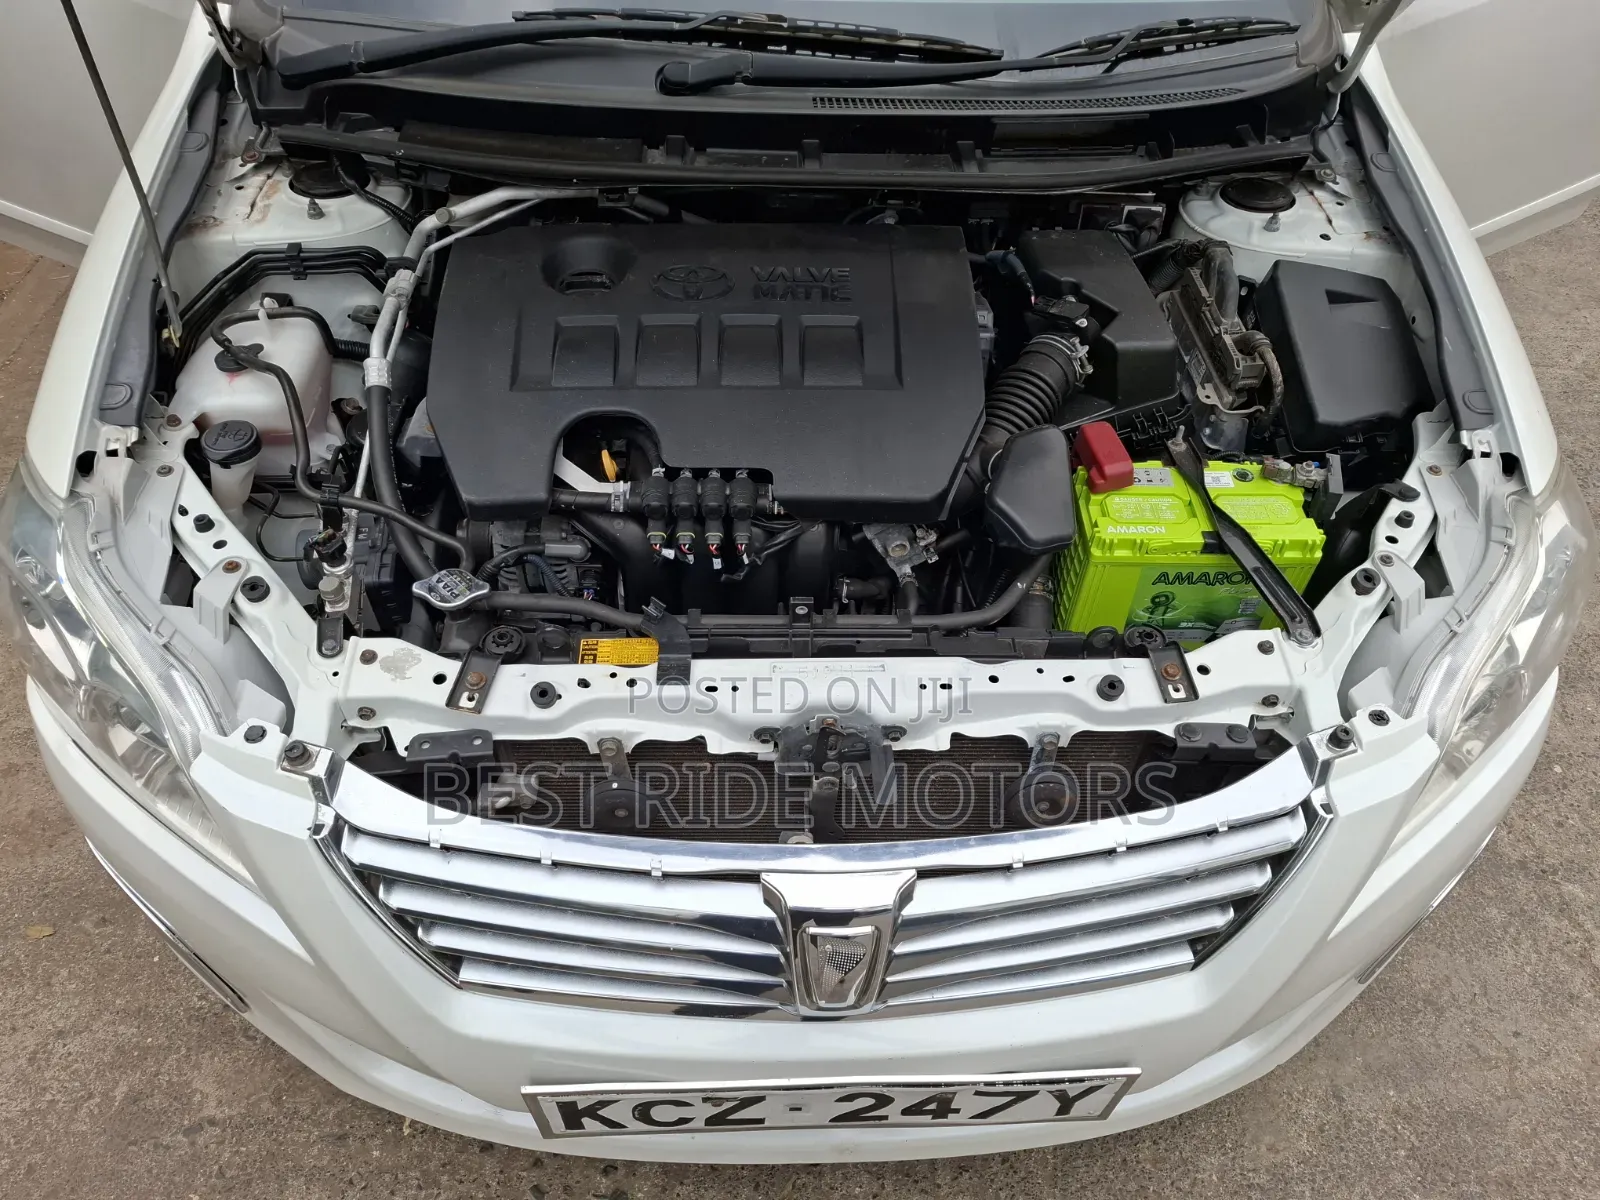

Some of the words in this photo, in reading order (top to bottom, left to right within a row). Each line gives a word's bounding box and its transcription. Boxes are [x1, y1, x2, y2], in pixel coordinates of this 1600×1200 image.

[751, 266, 850, 283] VALVE
[752, 283, 852, 302] MATIC
[1107, 525, 1166, 534] AMARON
[1151, 571, 1254, 587] AMARO
[435, 577, 461, 600] PIAA
[555, 1095, 767, 1132] KCZ
[828, 1084, 1110, 1123] 247Y
